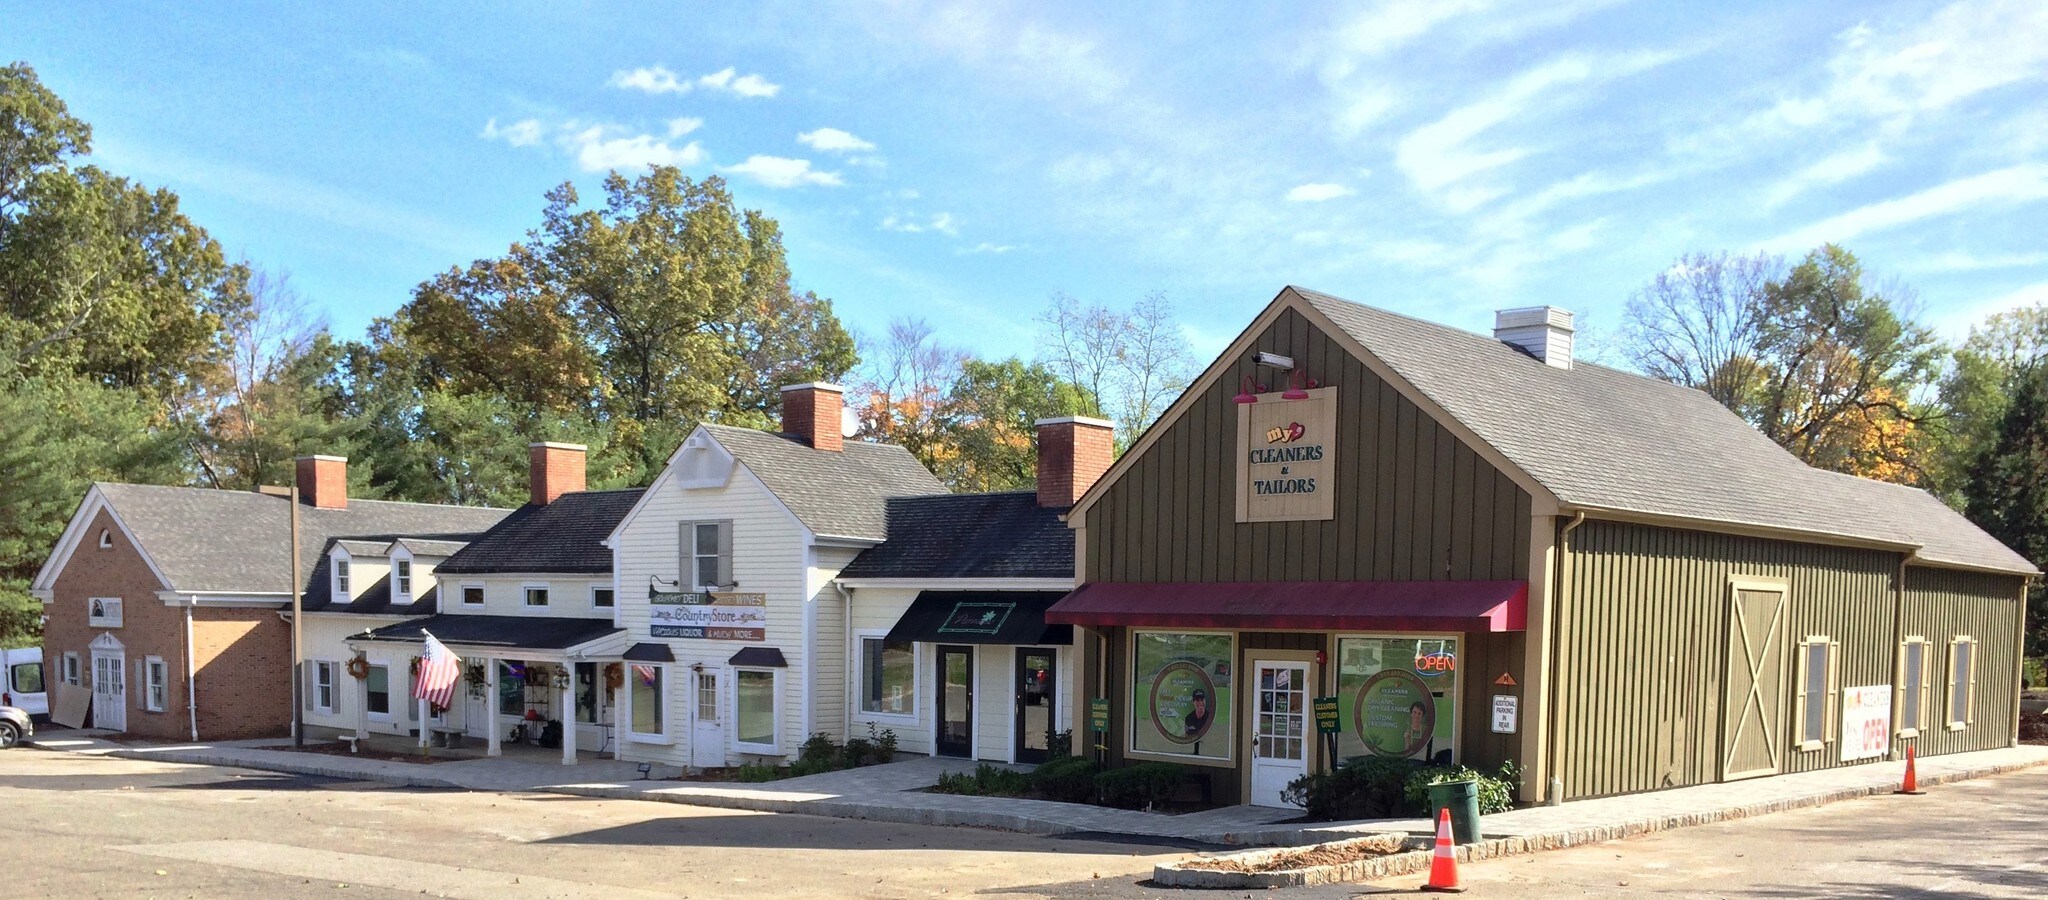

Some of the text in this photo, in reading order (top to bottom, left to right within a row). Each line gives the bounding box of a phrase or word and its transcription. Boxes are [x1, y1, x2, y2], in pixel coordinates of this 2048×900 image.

[1250, 445, 1323, 464] CLEANERS
[1281, 466, 1289, 475] &
[1254, 478, 1316, 494] TAILORS
[683, 593, 699, 603] DELI
[736, 595, 761, 605] WINES
[675, 607, 736, 625] Country Store
[680, 628, 703, 638] LIQUOR
[707, 630, 712, 638] &
[1415, 656, 1455, 671] OPEN
[1380, 705, 1410, 713] CLEANING
[1863, 718, 1888, 752] OPEN
